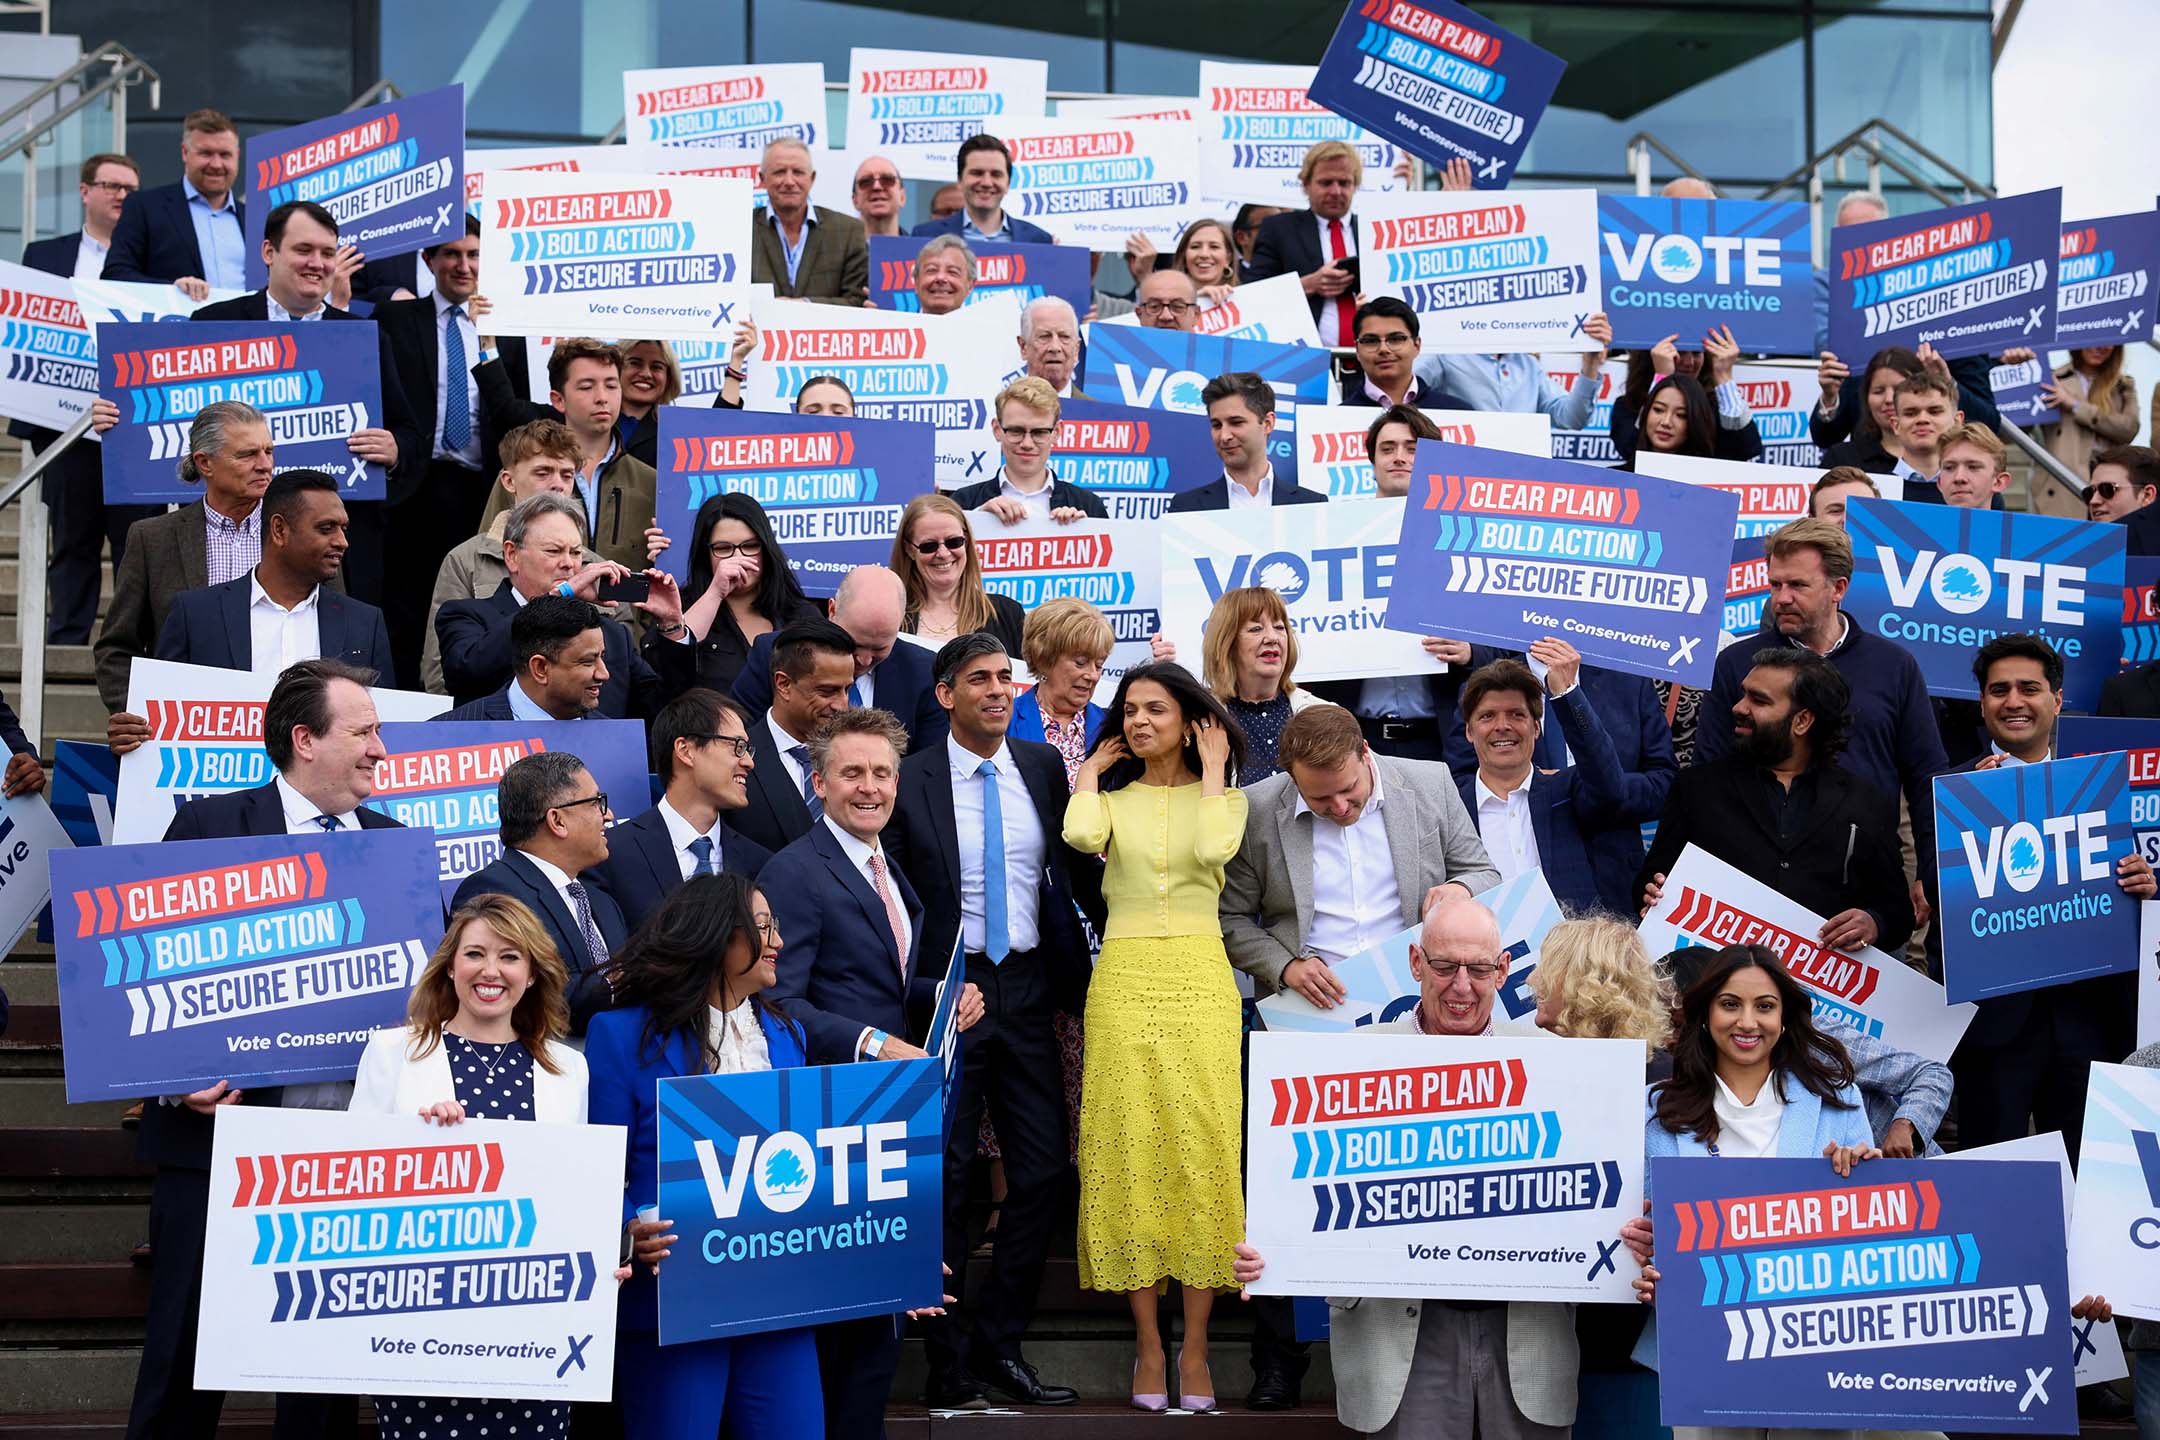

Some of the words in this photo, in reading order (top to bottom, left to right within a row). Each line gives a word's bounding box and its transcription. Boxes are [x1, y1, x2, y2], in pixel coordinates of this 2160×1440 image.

[1390, 3, 1441, 41] CLEAR
[1440, 23, 1487, 58] PLAN
[887, 71, 933, 91] CLEAR
[934, 69, 975, 89] PLAN
[1387, 36, 1432, 71] BOLD
[1431, 56, 1491, 94] ACTION
[661, 85, 710, 111] CLEAR
[710, 79, 749, 105] PLAN
[896, 97, 936, 117] BOLD
[936, 95, 990, 116] ACTION
[1238, 90, 1287, 111] CLEAR
[1385, 71, 1447, 114] SECURE
[1445, 95, 1508, 136] FUTURE
[716, 104, 769, 130] ACTION
[1250, 118, 1291, 139] BOLD
[1293, 118, 1347, 139] ACTION
[286, 142, 337, 177] CLEAR
[340, 121, 382, 158] PLAN
[1024, 137, 1074, 160] CLEAR
[1077, 134, 1118, 156] PLAN
[1394, 110, 1419, 131] Vote
[1418, 122, 1486, 166] Conservative
[299, 171, 340, 202] BOLD
[343, 146, 402, 186] ACTION
[375, 167, 435, 204] FUTURE
[1038, 164, 1079, 186] BOLD
[1081, 161, 1138, 184] ACTION
[532, 196, 595, 224] CLEAR
[600, 192, 651, 219] PLAN
[1050, 189, 1110, 213] SECURE
[1113, 184, 1173, 209] FUTURE
[359, 214, 434, 242] Conservative
[547, 230, 598, 256] BOLD
[602, 224, 674, 253] ACTION
[1403, 216, 1459, 245] CLEAR
[1462, 208, 1508, 237] PLAN
[1419, 248, 1464, 276] BOLD
[1468, 240, 1530, 270] ACTION
[1602, 231, 1782, 288] VOTE
[1871, 234, 1925, 268] CLEAR
[1928, 220, 1973, 253] PLAN
[560, 261, 636, 290] SECURE
[640, 255, 716, 285] FUTURE
[976, 258, 1009, 283] LAN
[1884, 264, 1928, 297] BOLD
[1931, 248, 1993, 284] ACTION
[1434, 277, 1500, 309] SECURE
[1503, 269, 1571, 300] FUTURE
[1609, 285, 1782, 313] Conservative
[1896, 286, 1959, 324] SECURE
[1963, 268, 2029, 306] FUTURE
[2064, 276, 2129, 307] FUTURE
[588, 303, 619, 315] Vote
[623, 304, 712, 318] Conservative
[1461, 320, 1488, 331] Vote
[1490, 319, 1569, 331] Conservative
[33, 328, 78, 356] BOLD
[795, 332, 854, 358] CLEAR
[859, 331, 906, 357] PLAN
[1918, 330, 1945, 342] Vote
[1947, 315, 2026, 338] Conservative
[151, 347, 218, 380] CLEAR
[221, 340, 275, 372] PLAN
[230, 375, 302, 407] ACTION
[861, 367, 928, 392] ACTION
[57, 398, 84, 413] Vote
[1113, 362, 1297, 433] VOE
[272, 409, 347, 441] FUTURE
[898, 401, 968, 430] FUTURE
[1757, 415, 1793, 440] TION
[710, 440, 775, 467] CLEAR
[780, 436, 832, 463] PLAN
[1081, 422, 1130, 450] PLAN
[783, 471, 856, 502] ACTION
[1080, 458, 1149, 486] ACTION
[1114, 496, 1172, 520] FUTUR
[1468, 480, 1545, 513] CLEAR
[1551, 485, 1615, 519] PLAN
[1748, 487, 1800, 512] PLAN
[823, 509, 898, 538] FUTURE
[1039, 537, 1091, 567] PLAN
[1480, 521, 1544, 553] BOLD
[1547, 527, 1637, 562] ACTION
[1193, 543, 1401, 606] VOTE
[1492, 563, 1586, 598] SECURE
[1589, 571, 1684, 608] FUTURE
[1875, 545, 2087, 627] VOTE
[1521, 609, 1560, 629] Vote
[1562, 617, 1671, 652] Conservative
[1724, 599, 1762, 630] BOL
[1878, 612, 2082, 658] Conserive
[187, 705, 263, 737] CLEAR
[202, 752, 264, 783] BOLD
[374, 754, 452, 791] CLEAR
[437, 842, 500, 874] ECUR
[1960, 809, 2111, 900] VOTE
[126, 869, 220, 924] CLEAR
[224, 857, 298, 911] PLAN
[1970, 888, 2113, 938] Conservative
[155, 919, 231, 973] BOLD
[237, 905, 336, 961] ACTION
[1787, 943, 1857, 991] PLAN
[181, 966, 289, 1021] SECURE
[297, 950, 401, 1002] FUTURE
[226, 1031, 273, 1055] Vote
[276, 1025, 382, 1050] Conservat
[1322, 1071, 1412, 1118] CLEAR
[1419, 1065, 1496, 1110] PLAN
[1344, 1125, 1418, 1170] BOLD
[1424, 1118, 1530, 1163] ACTION
[289, 1155, 387, 1199] CLEAR
[392, 1148, 473, 1193] PLAN
[693, 1119, 909, 1220] VOTE
[1364, 1175, 1473, 1224] SECURE
[1481, 1168, 1592, 1215] FUTURE
[309, 1211, 387, 1256] BOLD
[394, 1203, 504, 1252] ACTION
[1729, 1195, 1823, 1242] CLEAR
[1831, 1188, 1909, 1233] PLAN
[701, 1211, 909, 1266] Conservative
[1406, 1244, 1452, 1262] Vote
[1455, 1244, 1587, 1264] Conservative
[1756, 1248, 1833, 1296] BOLD
[1839, 1240, 1948, 1289] ACTION
[327, 1266, 444, 1313] SECURE
[452, 1259, 566, 1306] FUTURE
[1781, 1301, 1896, 1350] SECURE
[1902, 1293, 2016, 1341] FUTURE
[370, 1336, 417, 1356] Vote
[421, 1337, 558, 1361] Conservative
[1826, 1370, 1876, 1393] Vote
[1880, 1372, 2018, 1395] Conservative
